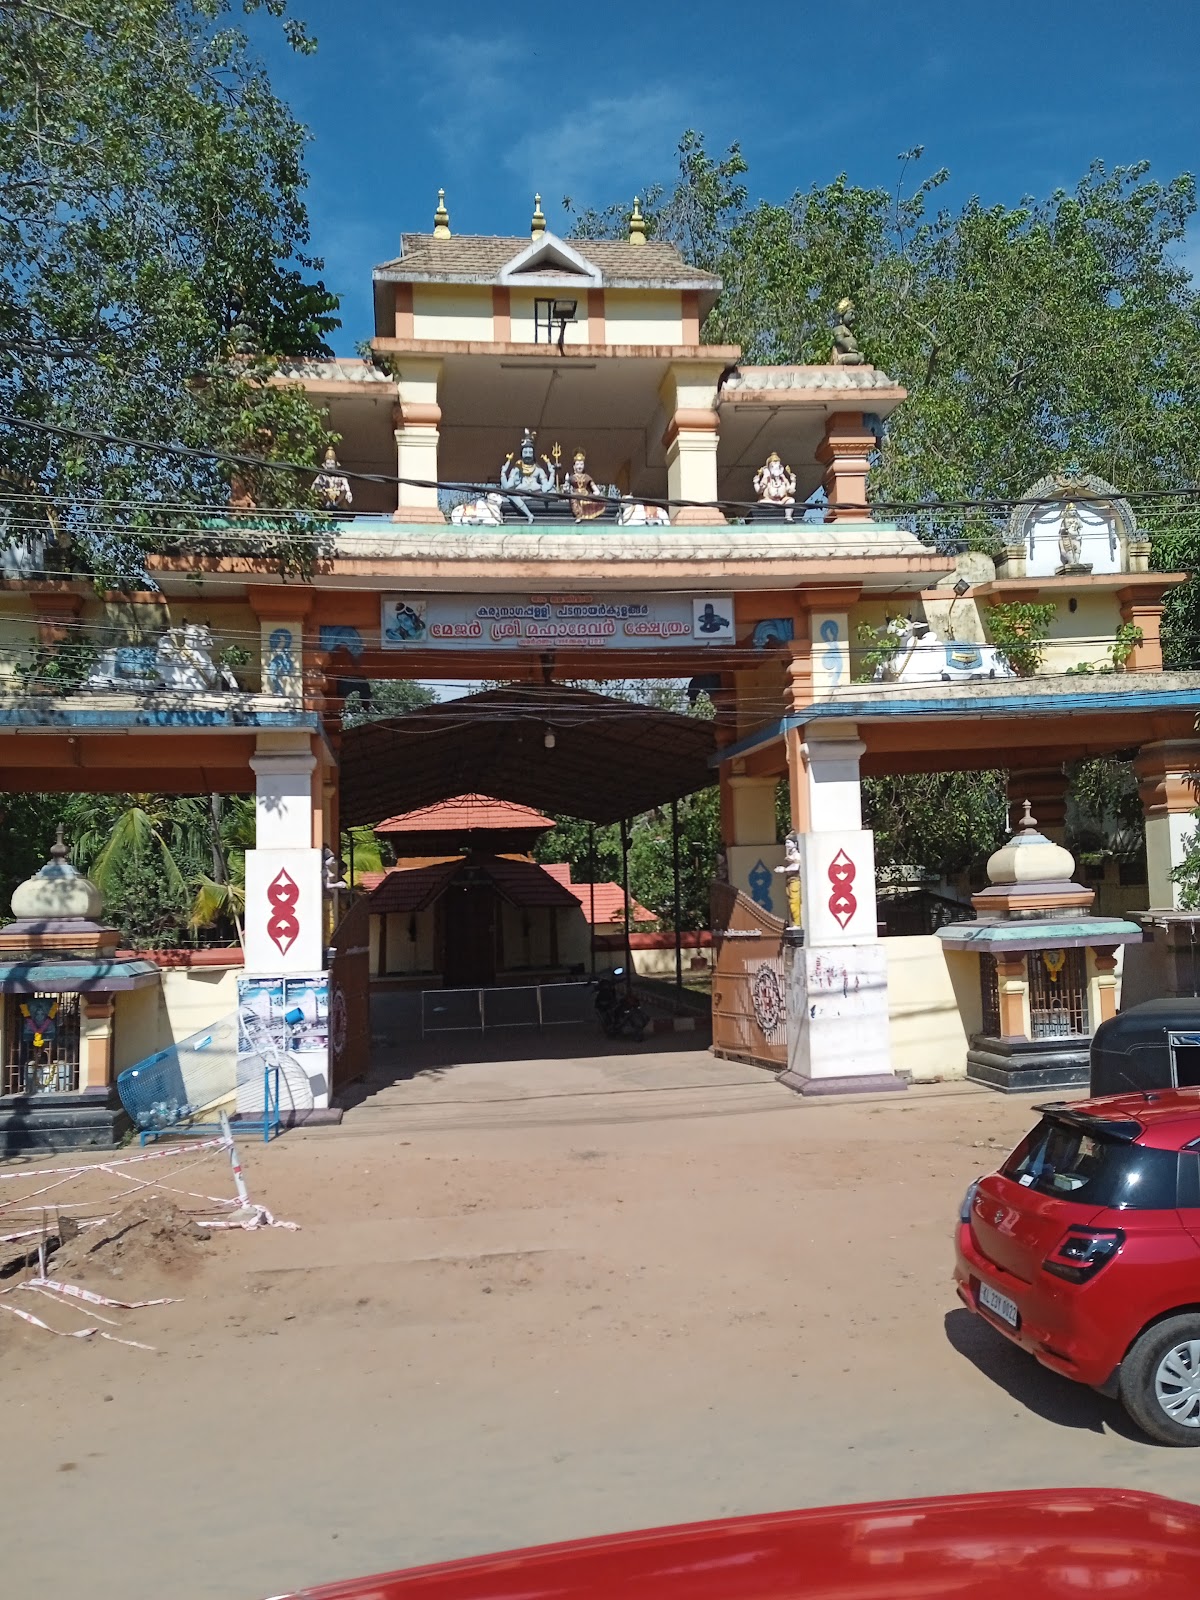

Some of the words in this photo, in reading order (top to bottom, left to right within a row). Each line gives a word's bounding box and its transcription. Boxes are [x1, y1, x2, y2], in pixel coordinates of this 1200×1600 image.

[477, 604, 551, 618] കരുനാഗപ്പള്ളി
[432, 620, 482, 636] മേജർ
[491, 619, 521, 639] ശ്രീ
[526, 619, 616, 636] മഹാദേവർ
[624, 621, 691, 638] ക്ഷേത്രം
[982, 1287, 990, 1304] KL
